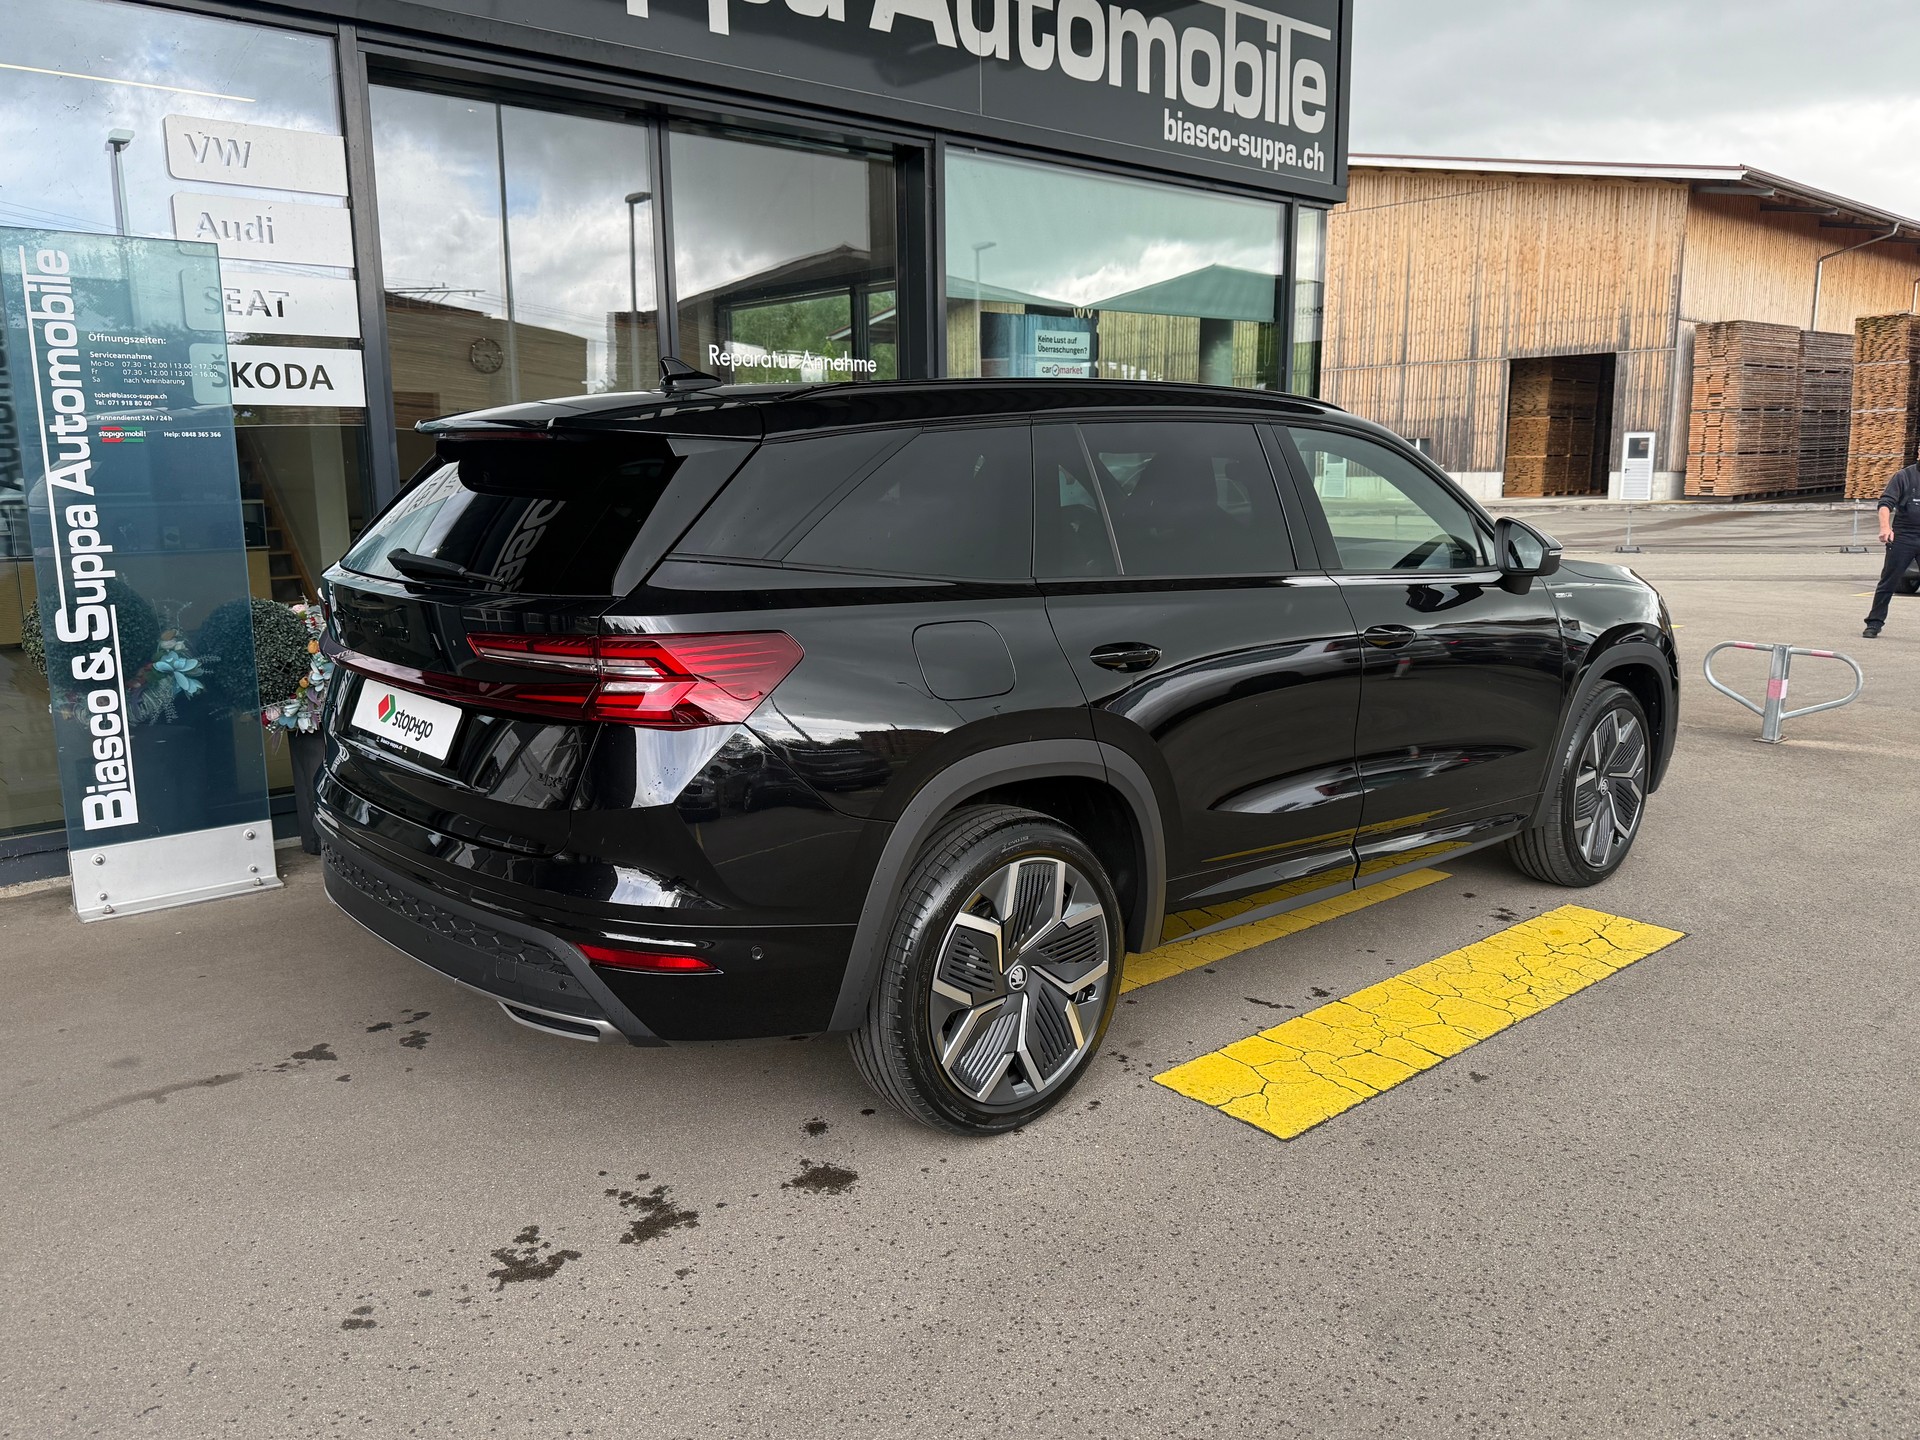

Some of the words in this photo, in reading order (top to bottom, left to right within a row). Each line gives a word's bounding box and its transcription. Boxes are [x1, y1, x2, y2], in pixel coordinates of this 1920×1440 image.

[184, 133, 251, 169] VW
[1163, 108, 1325, 172] biasco-suppa.ch
[196, 211, 275, 244] Audi
[203, 286, 290, 318] SEAT
[88, 332, 167, 345] Öffnungszeiten:
[1037, 335, 1053, 344] Keine
[1053, 336, 1066, 344] Lust
[1037, 343, 1088, 355] Überraschungen?
[89, 351, 152, 360] Serviceannahme
[708, 344, 794, 372] Reparatur
[800, 350, 877, 373] Annahme
[25, 249, 95, 496] Automobile
[142, 378, 185, 386] Vereinbarung
[210, 353, 335, 391] ŠKODA
[94, 392, 167, 400] tobel@biasco-suppa.ch
[55, 504, 116, 643] Suppa
[71, 646, 116, 681] &
[82, 689, 138, 831] Biasco
